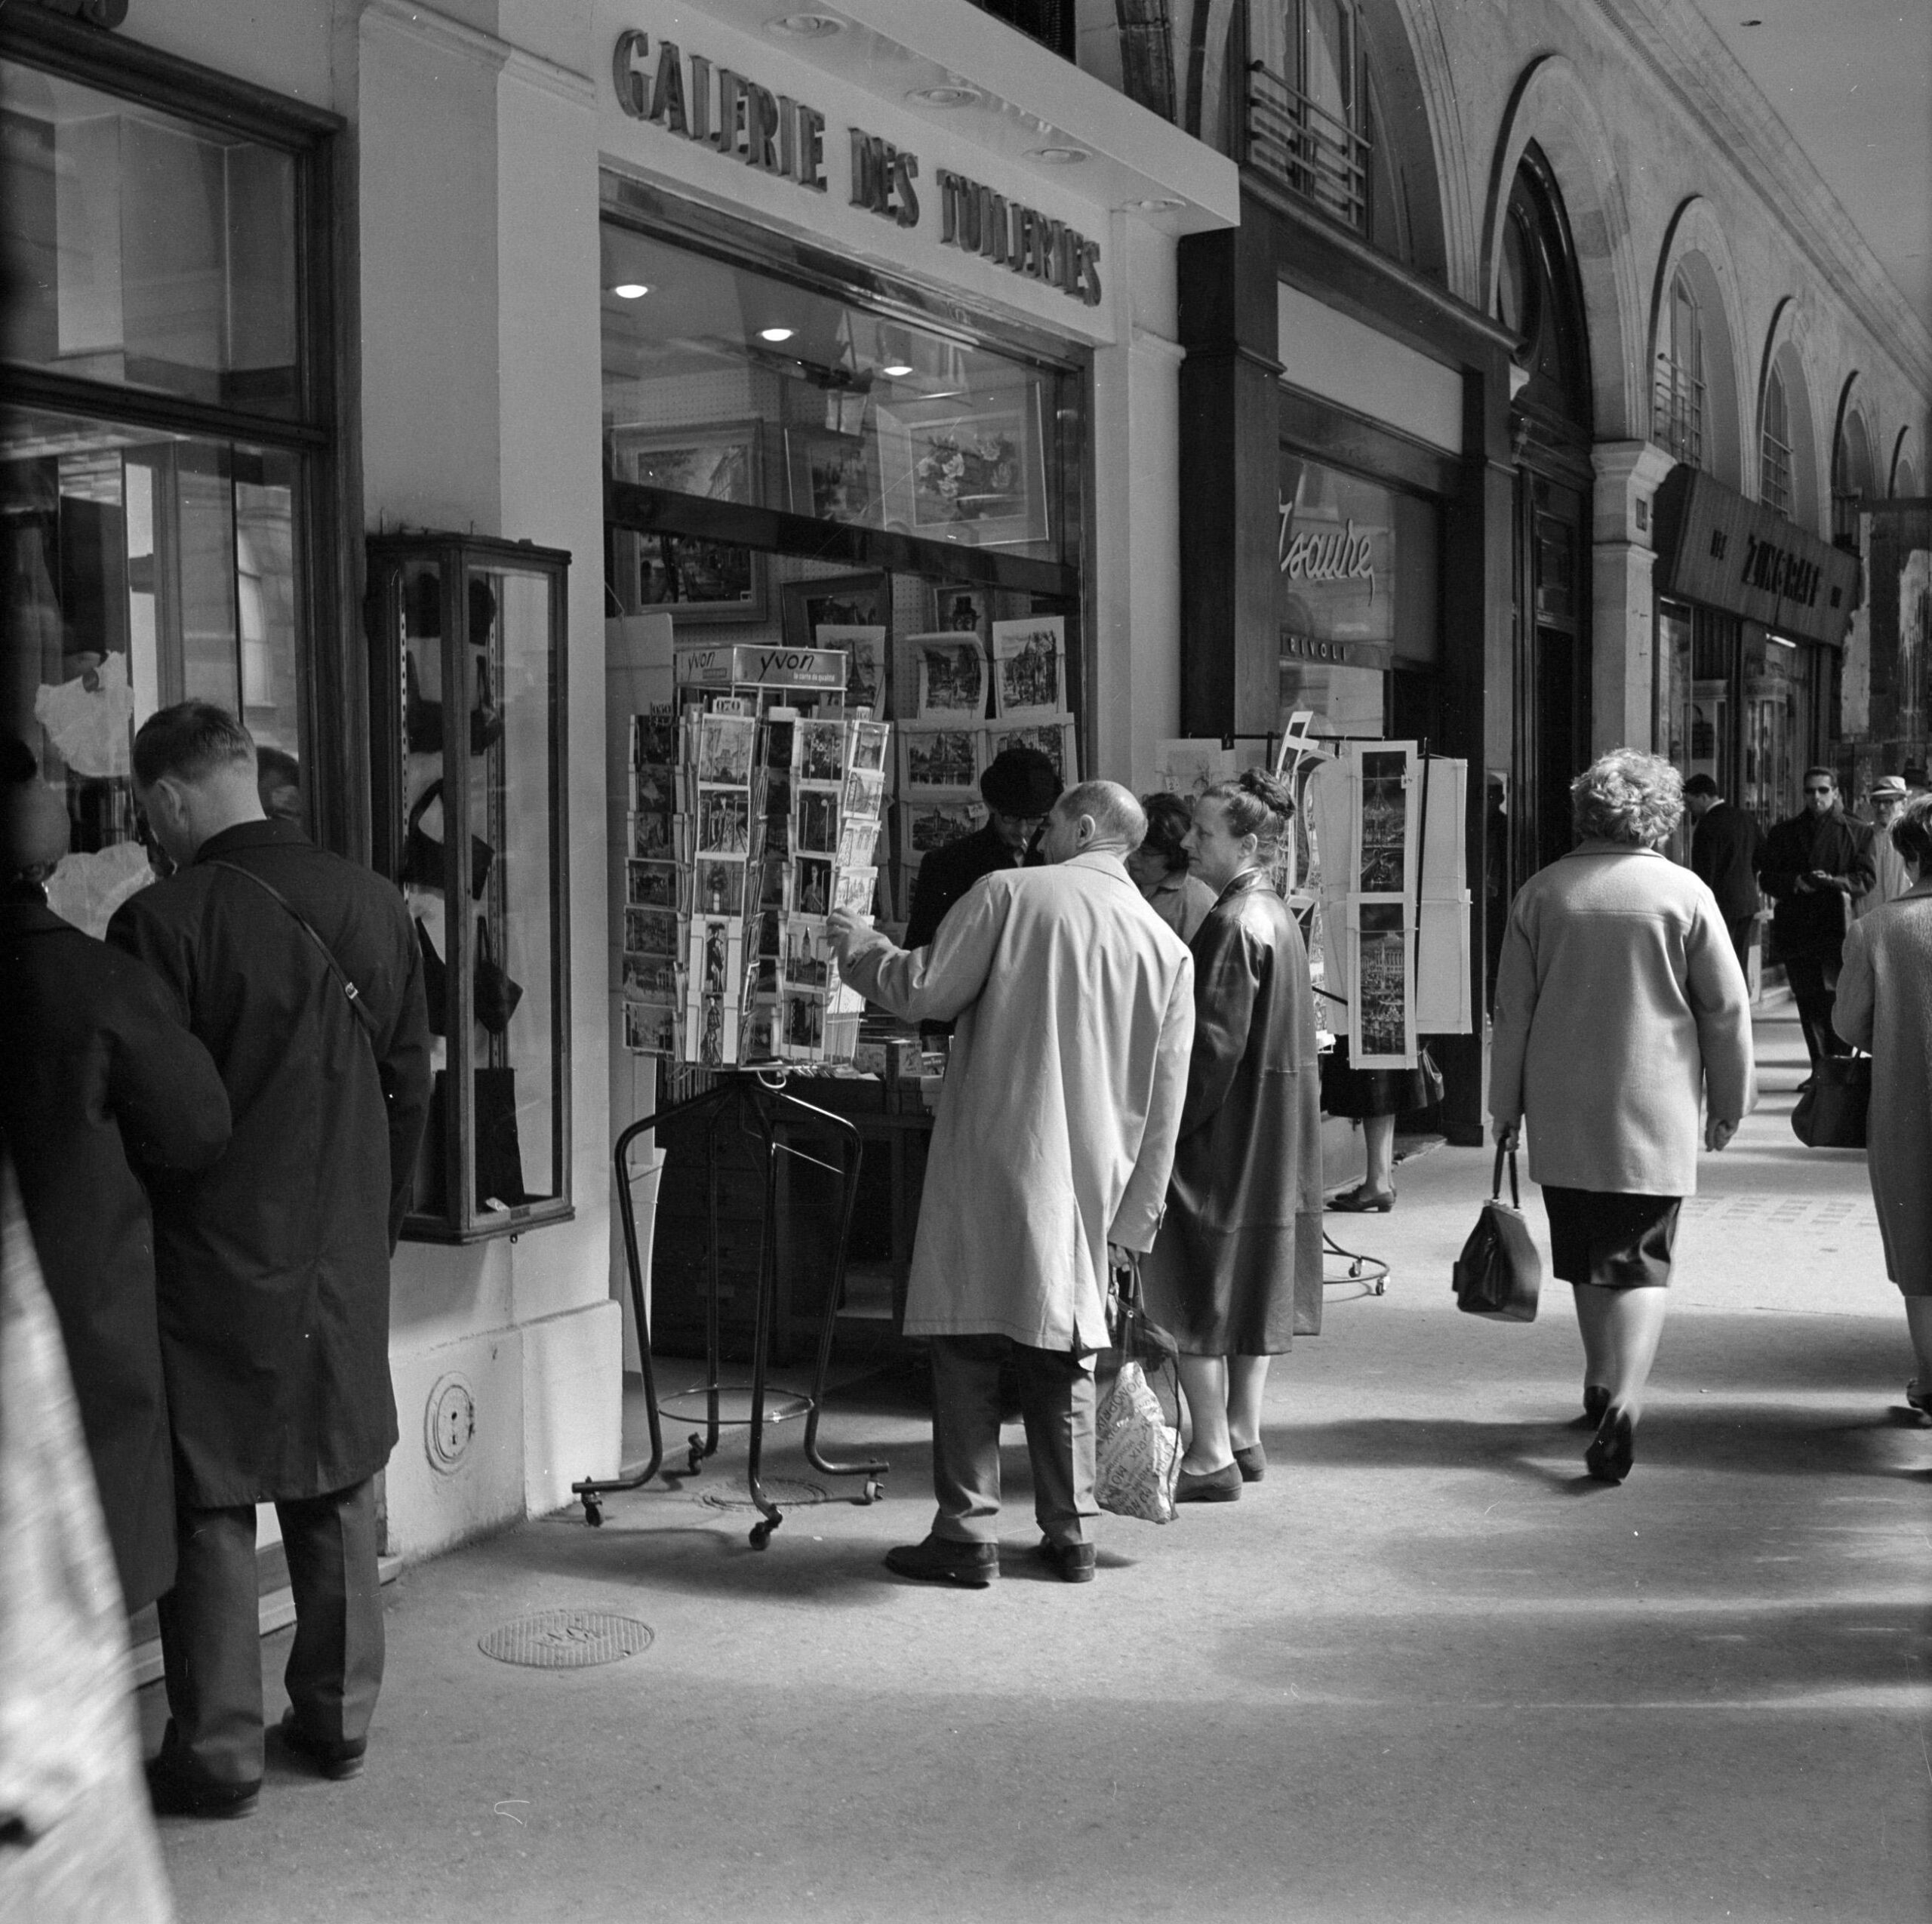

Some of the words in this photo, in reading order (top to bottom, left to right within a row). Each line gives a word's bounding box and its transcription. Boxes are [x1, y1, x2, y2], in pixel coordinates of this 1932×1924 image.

[613, 29, 827, 193] GALERIE
[848, 126, 919, 228] DES
[936, 168, 1102, 306] TUILERIES
[1290, 637, 1346, 662] RIVOLI
[758, 651, 815, 682] yvon
